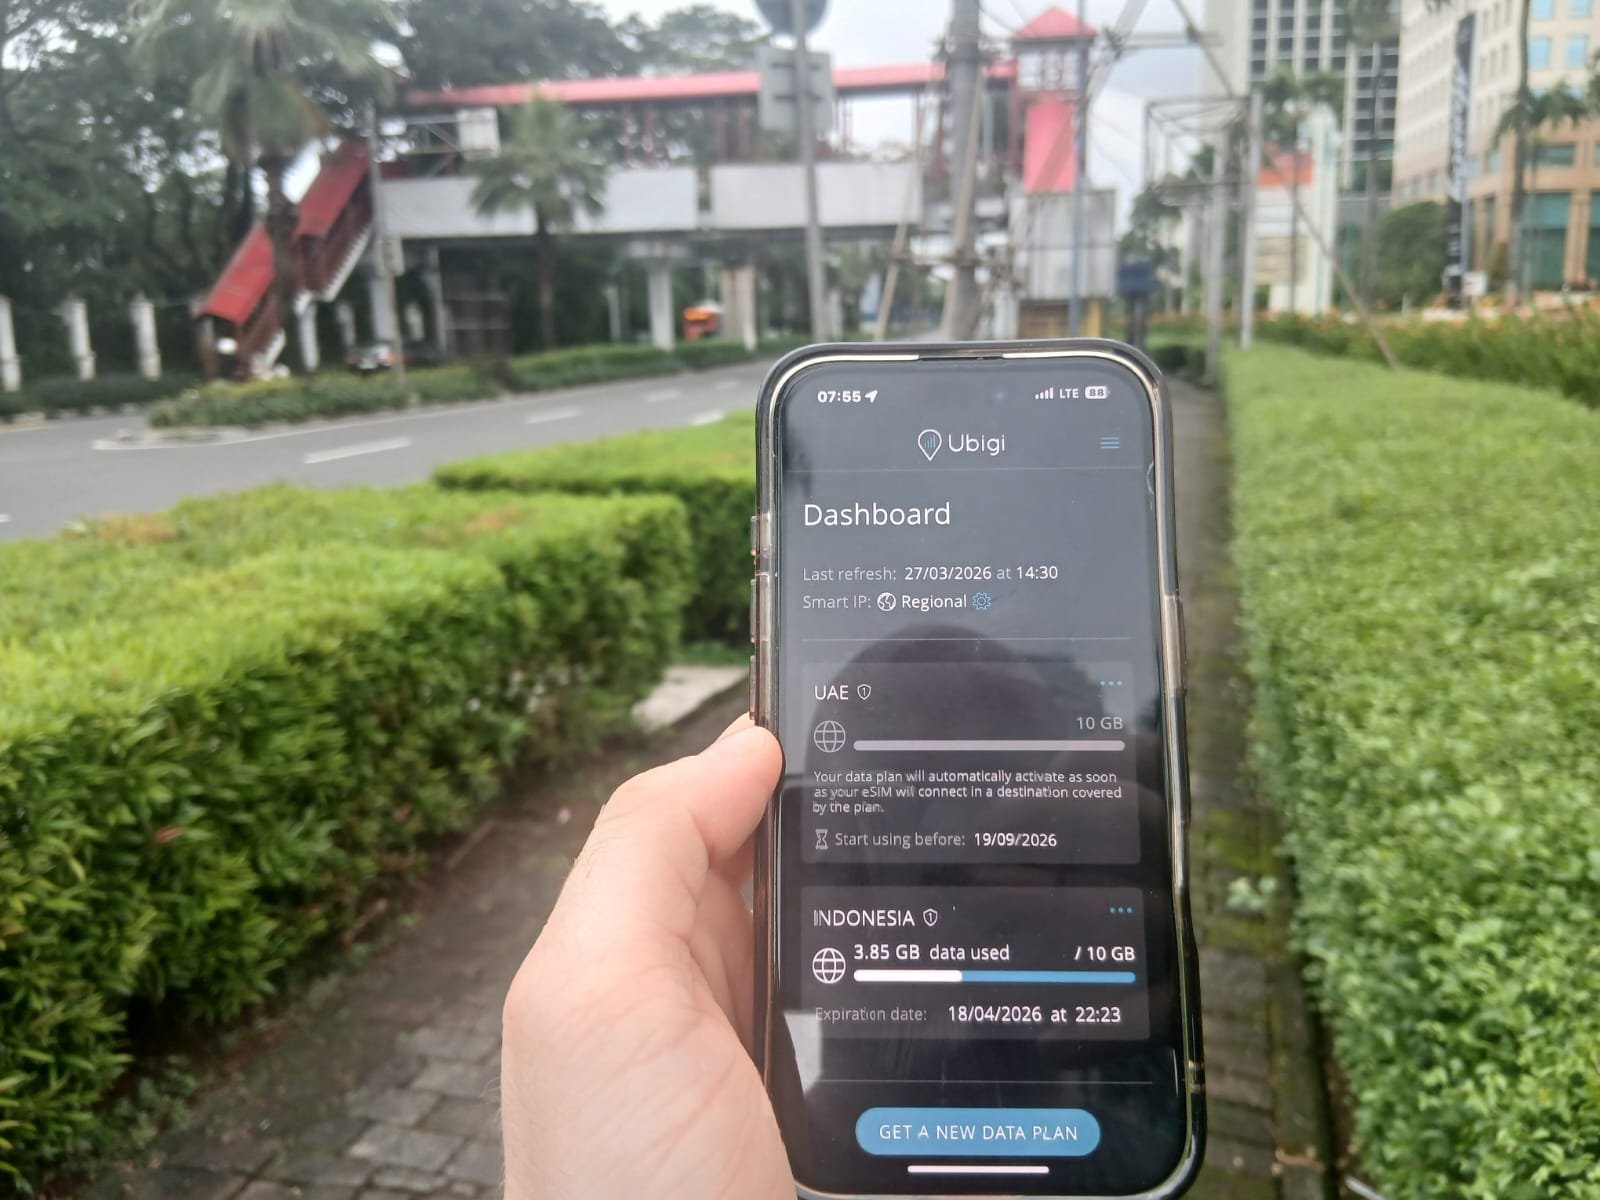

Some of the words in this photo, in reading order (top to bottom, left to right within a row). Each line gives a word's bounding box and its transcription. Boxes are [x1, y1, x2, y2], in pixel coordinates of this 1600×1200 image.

[817, 389, 862, 403] 07:55
[1059, 388, 1079, 399] LTE
[947, 433, 1006, 456] Ubigi
[804, 501, 951, 527] Dashboard
[803, 567, 834, 581] Last
[838, 566, 897, 581] refresh:
[904, 565, 992, 581] 27/03/2026
[996, 567, 1012, 580] at
[1016, 565, 1059, 580] 14:30
[803, 594, 849, 609] Smart
[853, 595, 872, 609] IP:
[902, 594, 967, 612] Regional
[814, 684, 849, 700] UAE
[1076, 716, 1095, 730] 10
[1100, 716, 1124, 731] GB
[813, 770, 843, 783] Your
[845, 770, 873, 783] data
[876, 770, 903, 785] plan
[906, 769, 925, 782] will
[928, 769, 1012, 785] automatically
[1015, 770, 1065, 783] activate
[1068, 773, 1083, 783] as
[1085, 773, 1117, 783] soon
[814, 787, 828, 798] as
[829, 787, 859, 800] your
[862, 786, 892, 798] eSIM
[918, 786, 968, 798] connect
[971, 785, 983, 797] in
[985, 787, 993, 798] a
[997, 785, 1069, 798] destination
[1072, 786, 1122, 799] covered
[812, 800, 827, 816] by
[829, 800, 850, 813] the
[853, 800, 885, 816] plan.
[834, 832, 869, 847] Start
[872, 832, 911, 850] using
[915, 831, 966, 847] before:
[973, 832, 1058, 848] 19/09/2026
[813, 909, 915, 927] INDONESIA
[853, 944, 890, 960] 3.85
[895, 944, 920, 961] GB
[929, 943, 967, 961] data
[970, 944, 1010, 961] used
[1086, 946, 1107, 961] 10
[1111, 946, 1135, 962] GB
[815, 1006, 886, 1024] Expiration
[890, 1006, 928, 1022] date:
[948, 1005, 1043, 1023] 18/04/2026
[1050, 1008, 1067, 1023] at
[1075, 1006, 1122, 1023] 22:23
[879, 1124, 913, 1140] GET
[917, 1124, 930, 1140] A
[936, 1124, 976, 1140] NEW
[983, 1125, 1026, 1141] DATA
[1033, 1125, 1078, 1141] PLAN
